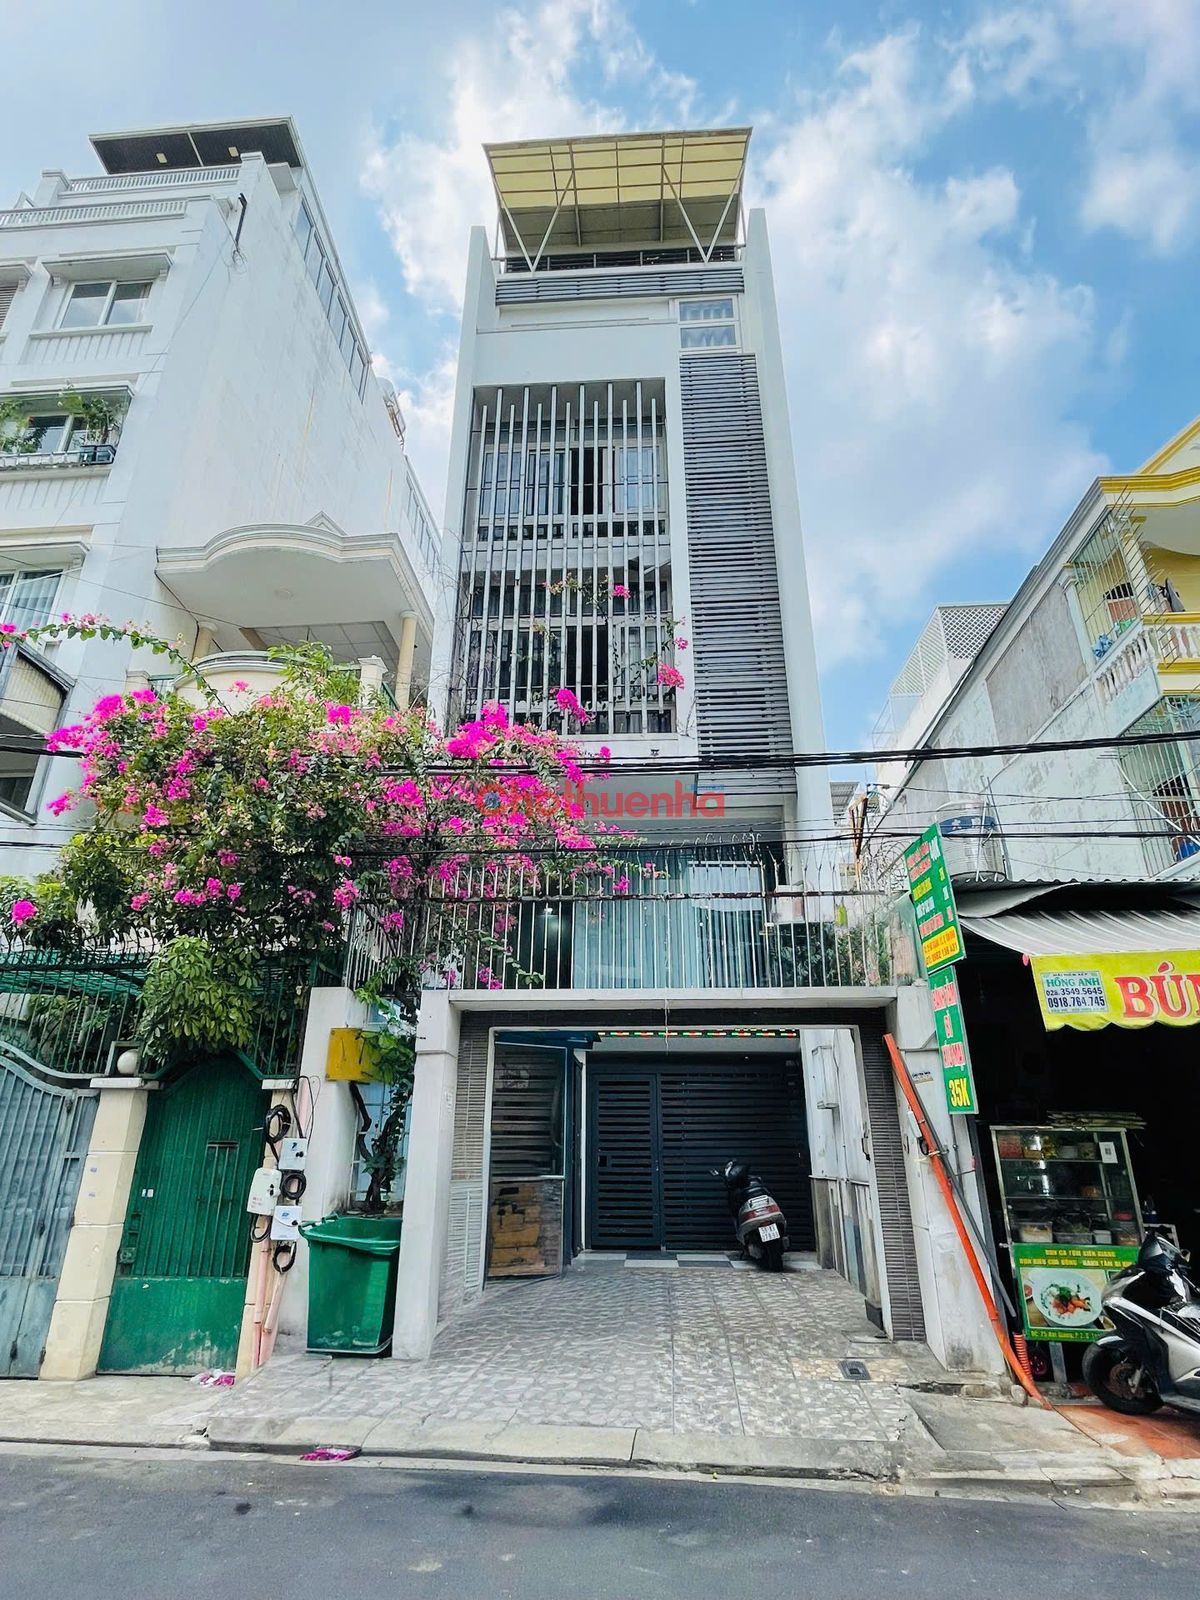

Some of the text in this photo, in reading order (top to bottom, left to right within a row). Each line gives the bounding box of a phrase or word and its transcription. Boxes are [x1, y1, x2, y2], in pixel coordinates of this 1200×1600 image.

[1079, 978, 1100, 986] ANH
[1047, 996, 1105, 1008] 0918.764.745
[948, 1078, 970, 1107] 35K
